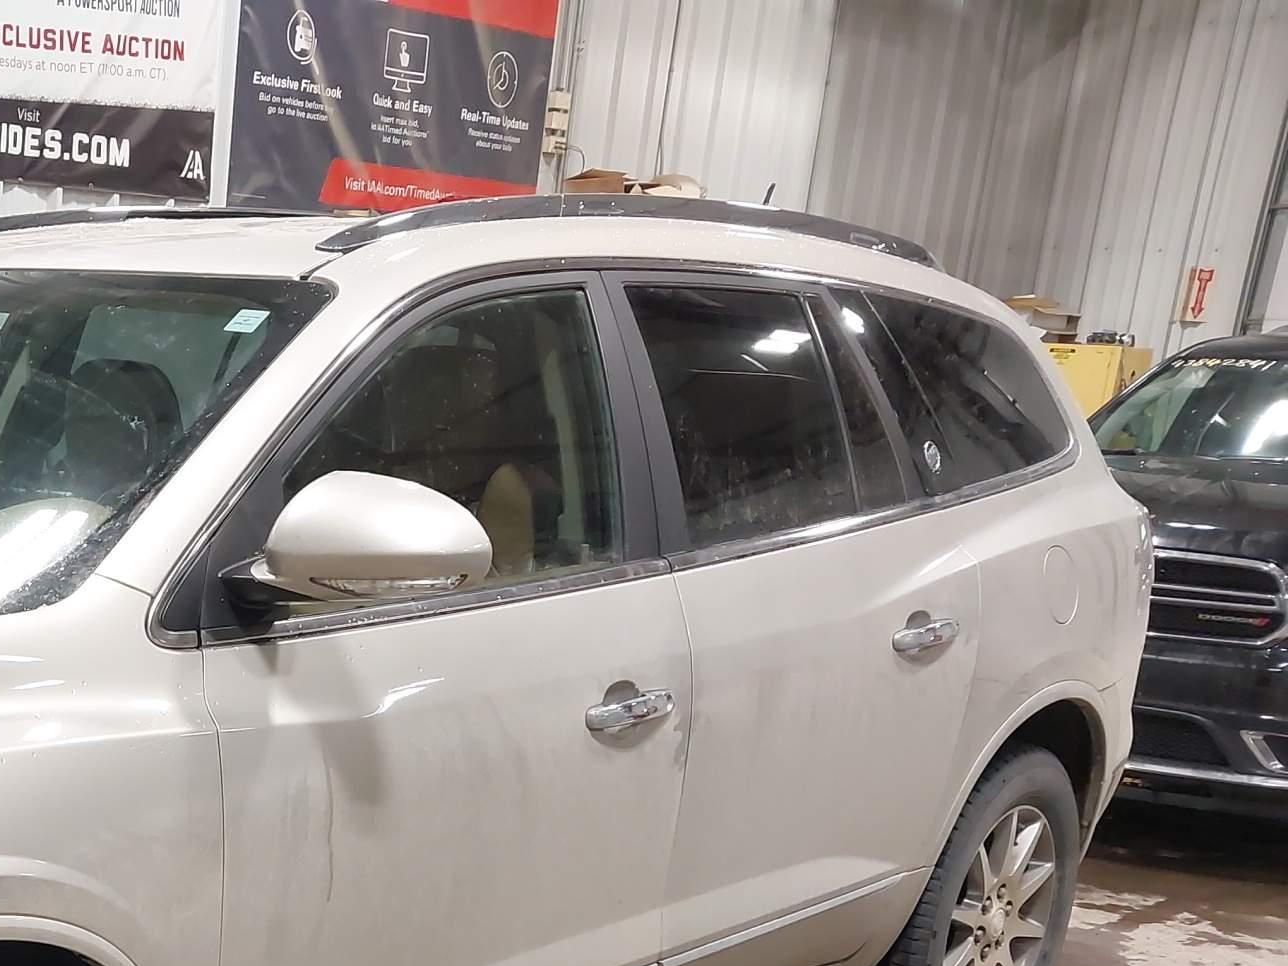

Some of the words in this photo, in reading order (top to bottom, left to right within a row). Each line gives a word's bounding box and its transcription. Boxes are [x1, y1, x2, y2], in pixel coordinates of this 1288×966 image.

[140, 0, 180, 18] AUCTION
[101, 33, 185, 61] AUCTION
[35, 60, 46, 71] at
[50, 62, 76, 73] noon
[80, 62, 94, 74] ET
[253, 71, 299, 90] Exclusive
[301, 79, 321, 95] First
[259, 92, 271, 101] Bid
[272, 95, 280, 103] on
[282, 96, 304, 107] vehicles
[373, 93, 393, 109] Quick
[394, 99, 411, 111] and
[412, 100, 433, 118] Easy
[17, 108, 41, 122] Visit
[267, 106, 276, 115] go
[278, 106, 285, 114] to
[286, 107, 295, 116] the
[296, 109, 305, 118] live
[306, 111, 328, 121] auction
[461, 108, 501, 126] Real-Time
[502, 115, 529, 130] Updates
[345, 176, 365, 191] Visit
